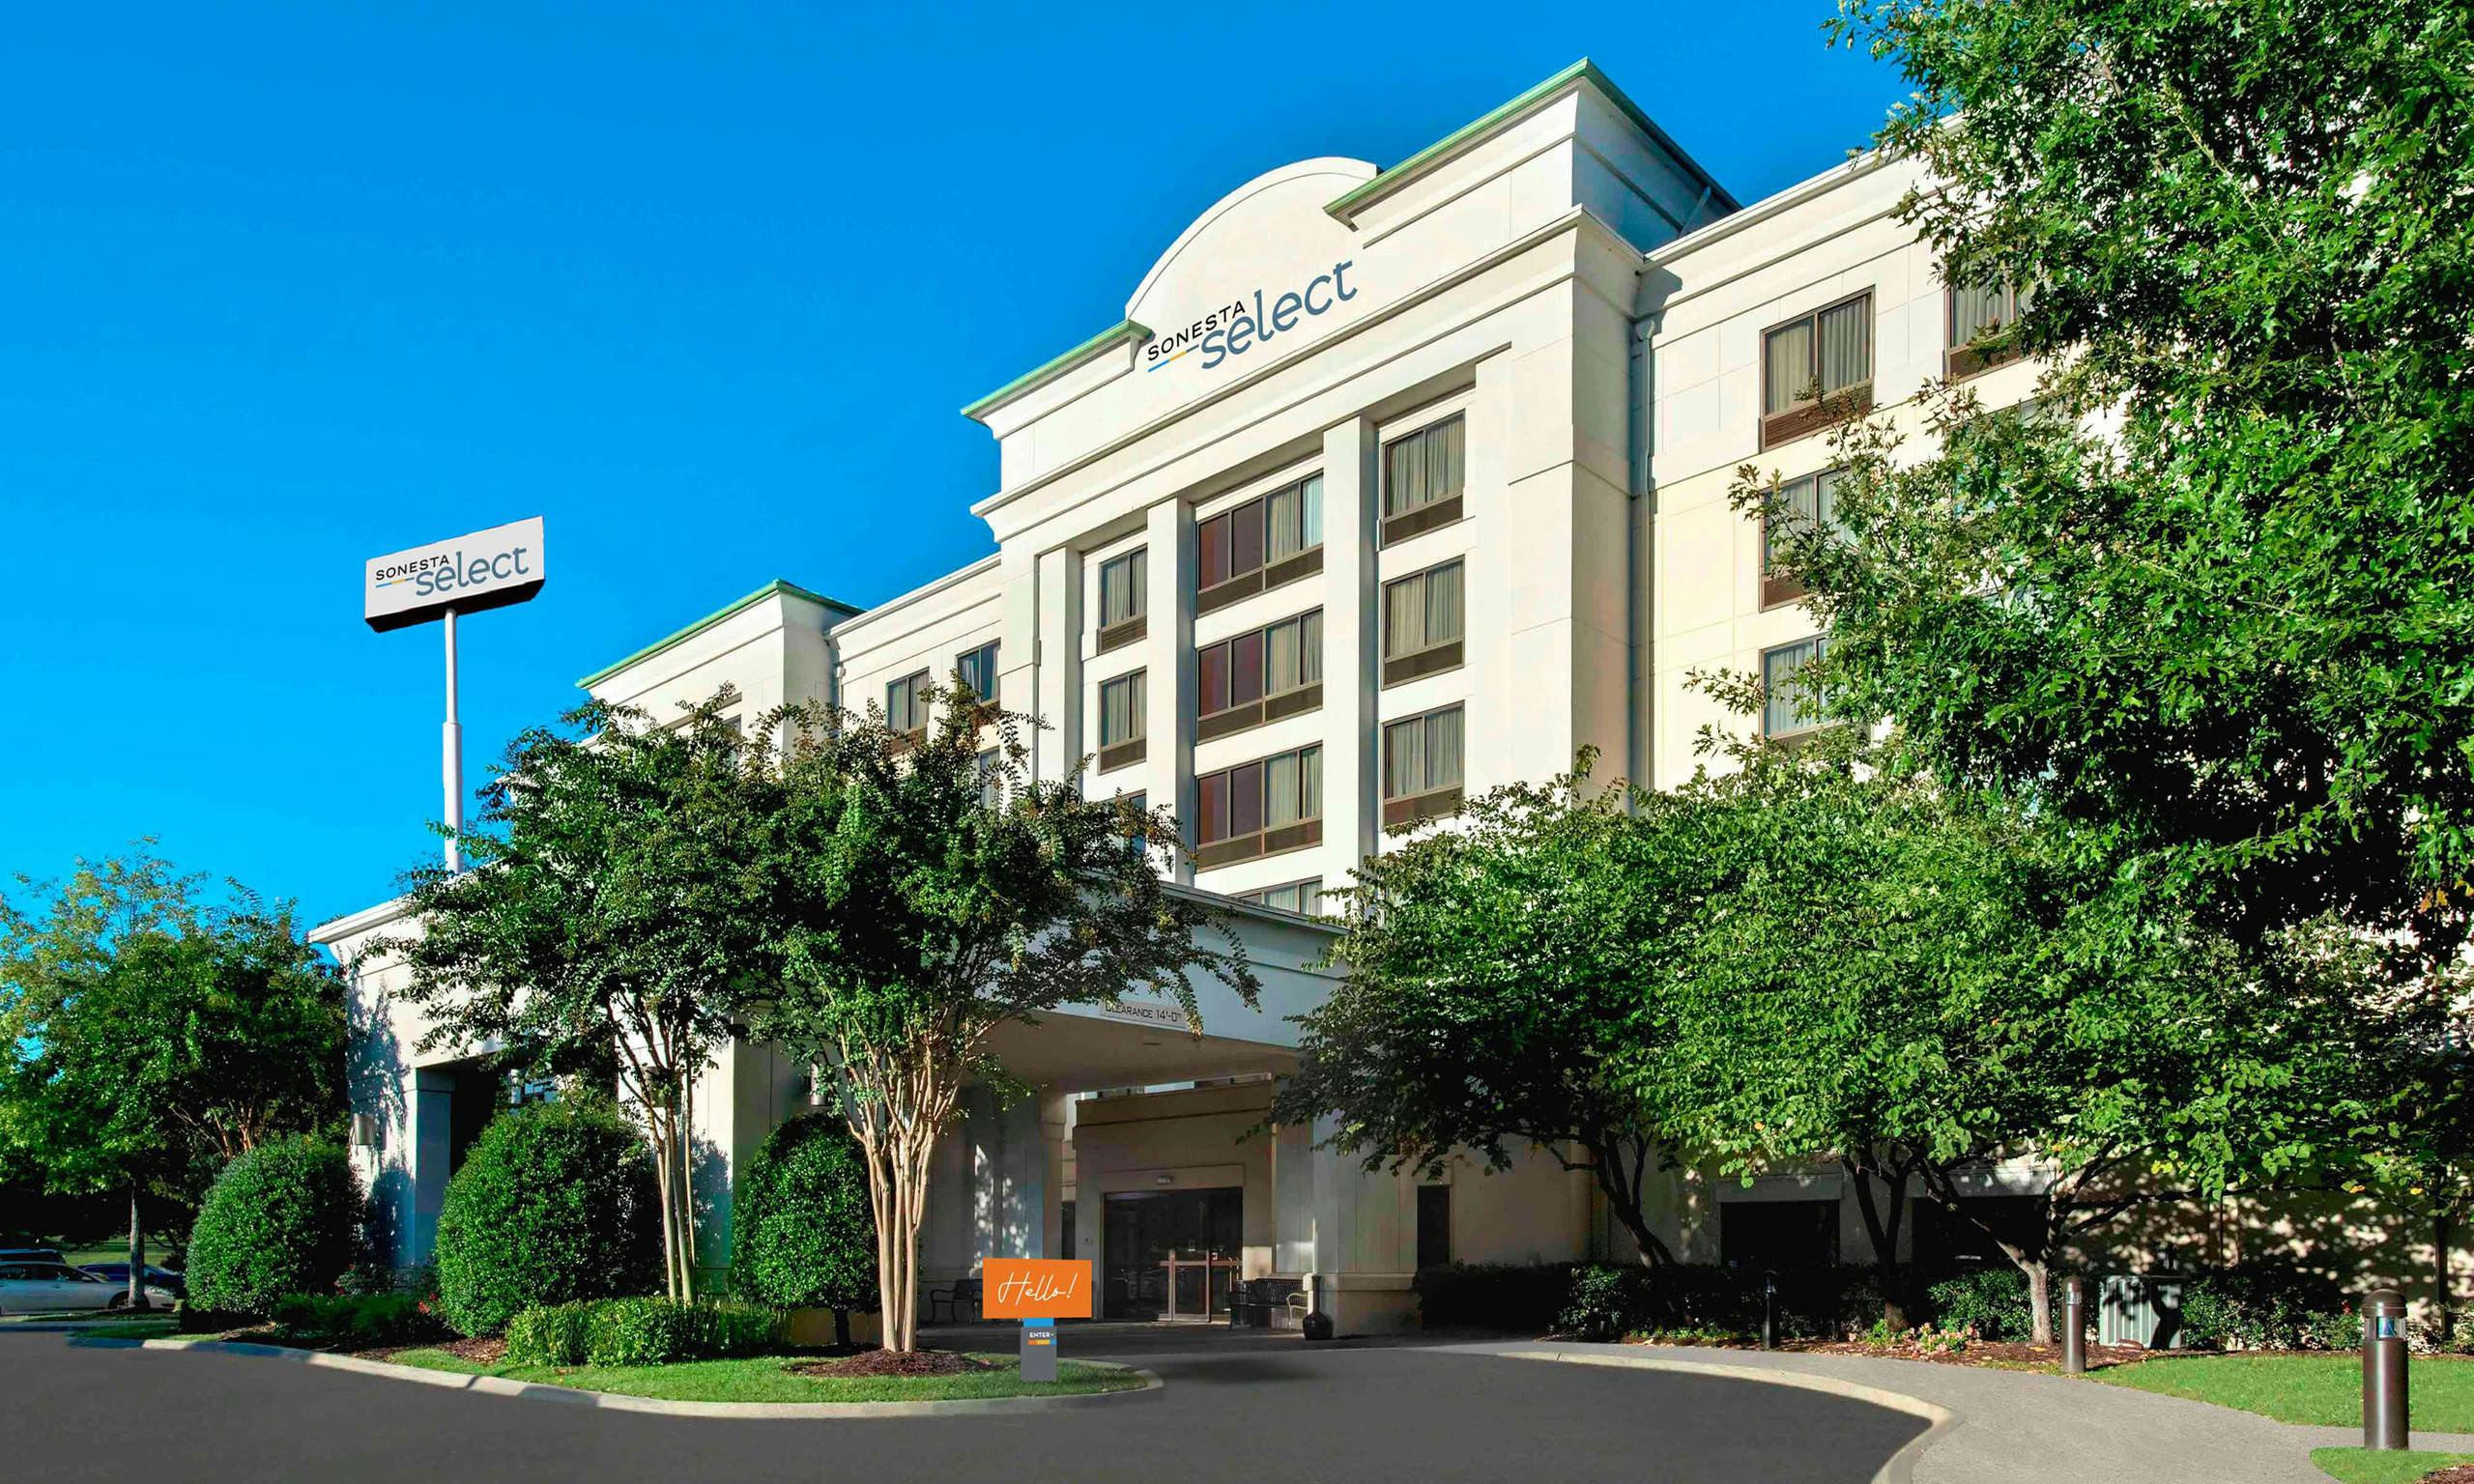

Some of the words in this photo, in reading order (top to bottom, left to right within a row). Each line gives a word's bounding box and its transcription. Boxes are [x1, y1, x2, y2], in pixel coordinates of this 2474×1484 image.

[1147, 300, 1246, 361] SONESTA
[1201, 260, 1358, 369] select
[375, 555, 449, 581] SONESTA
[416, 547, 530, 596] select
[997, 1270, 1079, 1306] Hello!
